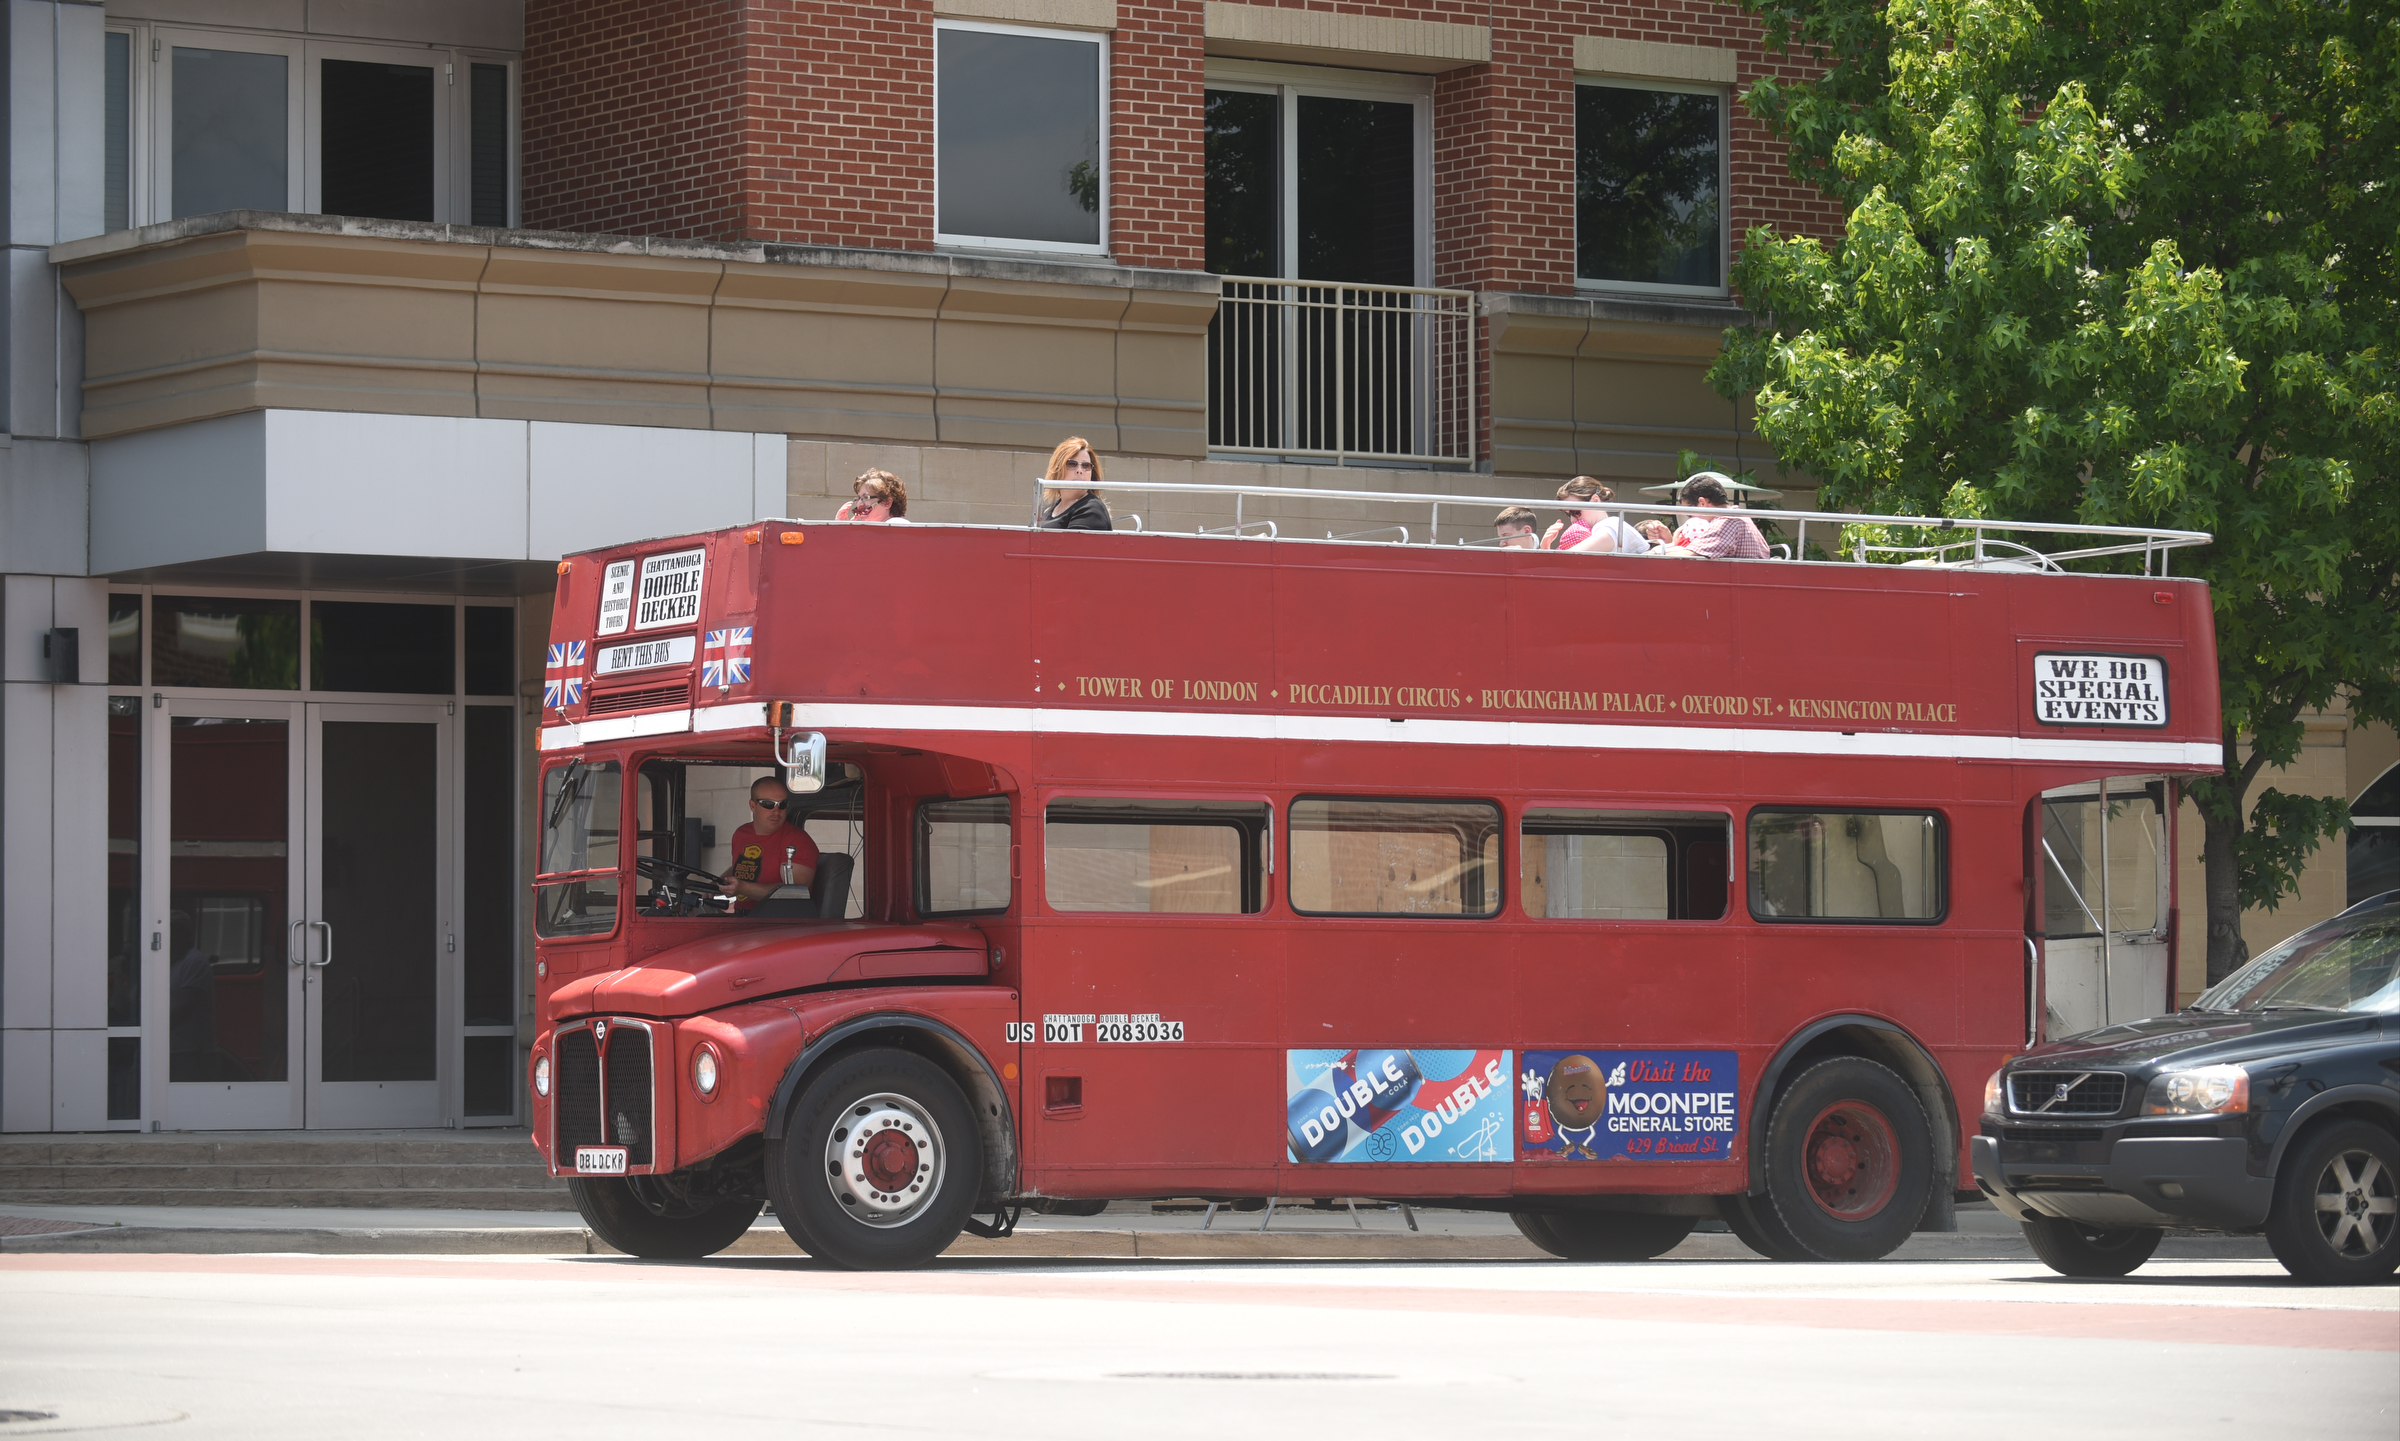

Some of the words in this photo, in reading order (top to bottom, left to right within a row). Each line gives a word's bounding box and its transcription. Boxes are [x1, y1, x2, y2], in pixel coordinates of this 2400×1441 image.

[610, 564, 630, 579] SCENIC
[646, 553, 701, 575] CHATTANOOGA
[612, 582, 625, 595] AND
[643, 570, 700, 600] DOUBLE
[603, 597, 629, 613] HISTORIC
[640, 594, 696, 624] DECKER
[605, 615, 624, 629] TOURS
[611, 646, 634, 669] RENT
[635, 644, 654, 667] THIS
[654, 641, 671, 664] BUS
[2048, 660, 2098, 679] WE
[2108, 661, 2147, 681] DO
[1076, 676, 1143, 699] TOWER
[1151, 678, 1174, 700] OF
[1183, 679, 1258, 702] LONDON
[1289, 683, 1393, 706] PICCADILLY
[1397, 686, 1460, 709] CIRCUS
[1481, 688, 1598, 712] BUCKINGHAM
[1602, 692, 1666, 714] PALACE
[1682, 694, 1748, 716] OXFORD
[1752, 697, 1774, 717] ST.
[1789, 698, 1892, 721] KENSINGTON
[1896, 702, 1958, 723] PALACE
[2039, 680, 2159, 702] SPECIAL
[2044, 701, 2158, 722] EVENTS
[1043, 1014, 1095, 1023] CHATTANOOGA
[1100, 1014, 1128, 1023] DOUBLE
[1131, 1014, 1160, 1023] DECKER
[1006, 1023, 1033, 1042] US
[1045, 1023, 1081, 1042] DOT
[1098, 1022, 1183, 1042] 2083036
[1630, 1060, 1675, 1082] Visit
[1681, 1061, 1711, 1082] the
[1388, 1078, 1408, 1096] COLA
[1301, 1054, 1404, 1148] DOUBLE
[1401, 1058, 1507, 1155] DOUBLE
[1608, 1092, 1734, 1114] MOONPIE
[1608, 1116, 1682, 1132] GENERAL
[1684, 1116, 1733, 1132] STORE
[1627, 1137, 1652, 1154] 429
[1655, 1137, 1699, 1154] Broad
[1700, 1136, 1719, 1153] St.
